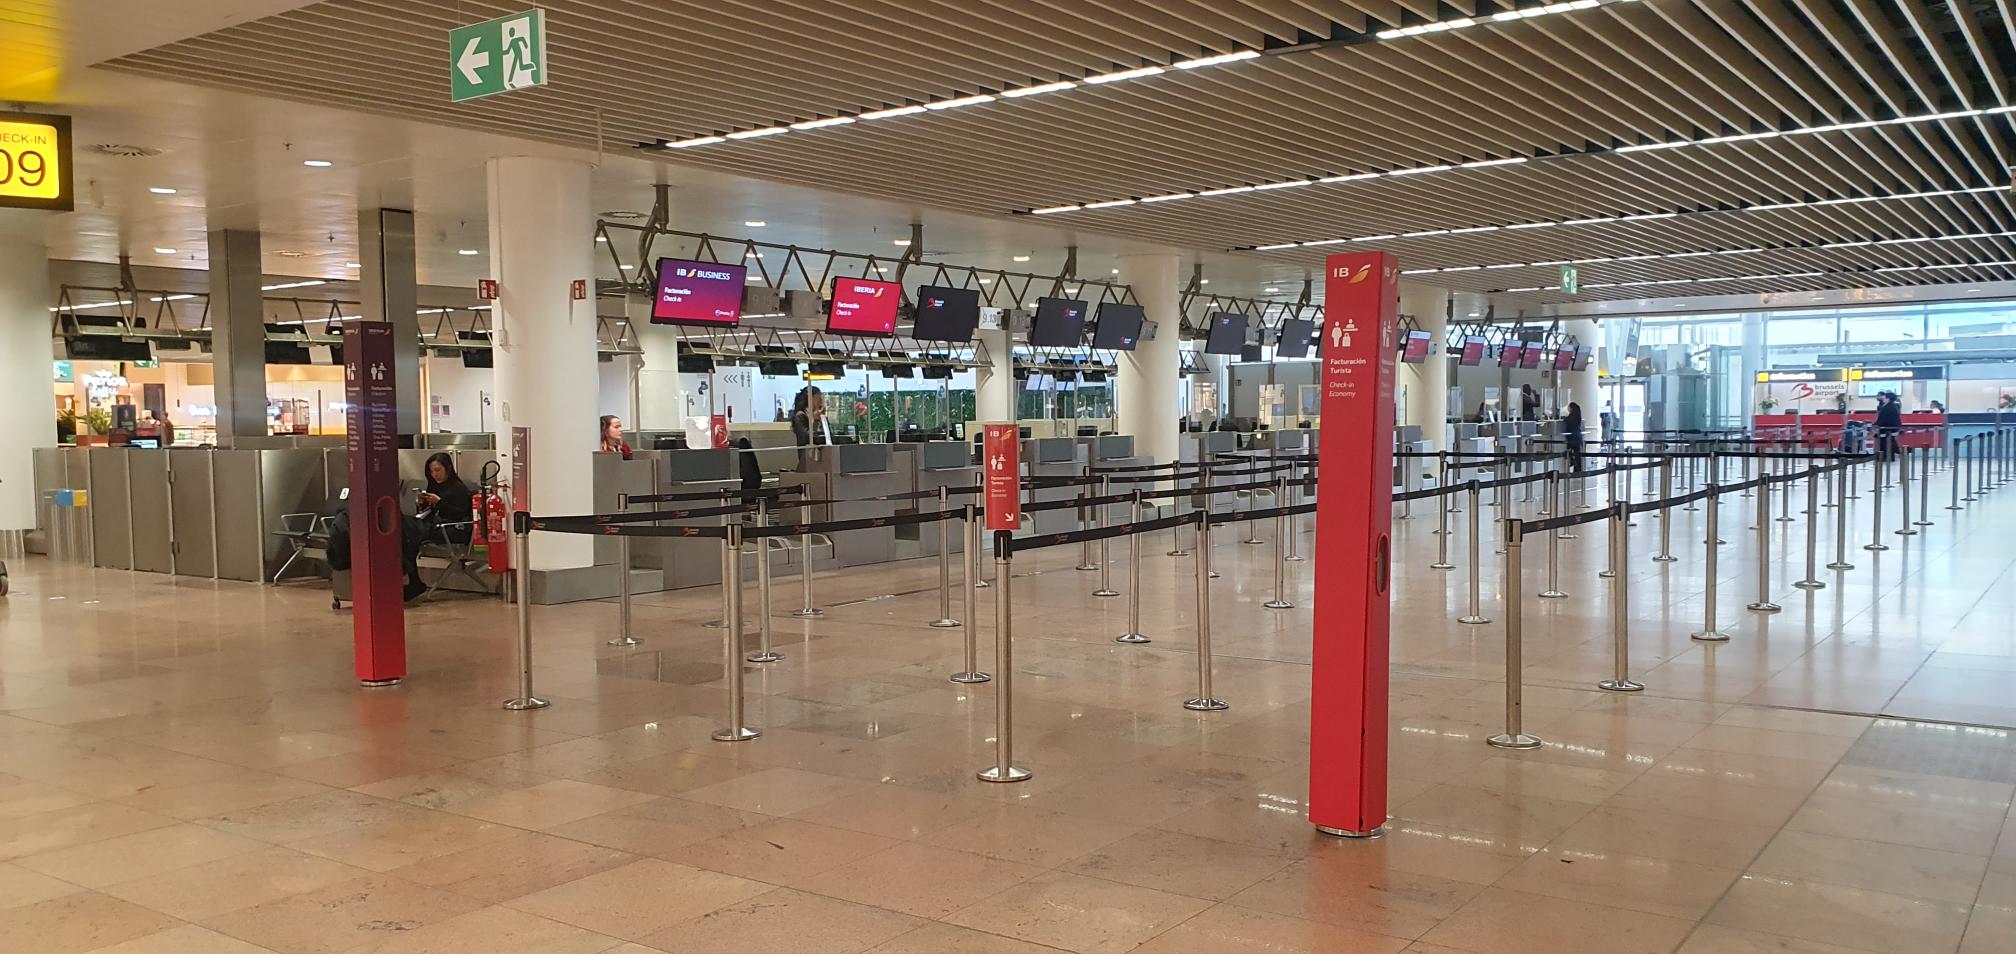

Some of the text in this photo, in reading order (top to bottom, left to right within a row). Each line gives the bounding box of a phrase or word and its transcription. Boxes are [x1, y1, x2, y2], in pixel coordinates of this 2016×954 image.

[0, 133, 46, 144] ECK-IN
[698, 270, 730, 280] BUSINESS
[1333, 267, 1350, 278] IB
[989, 430, 1000, 438] IB
